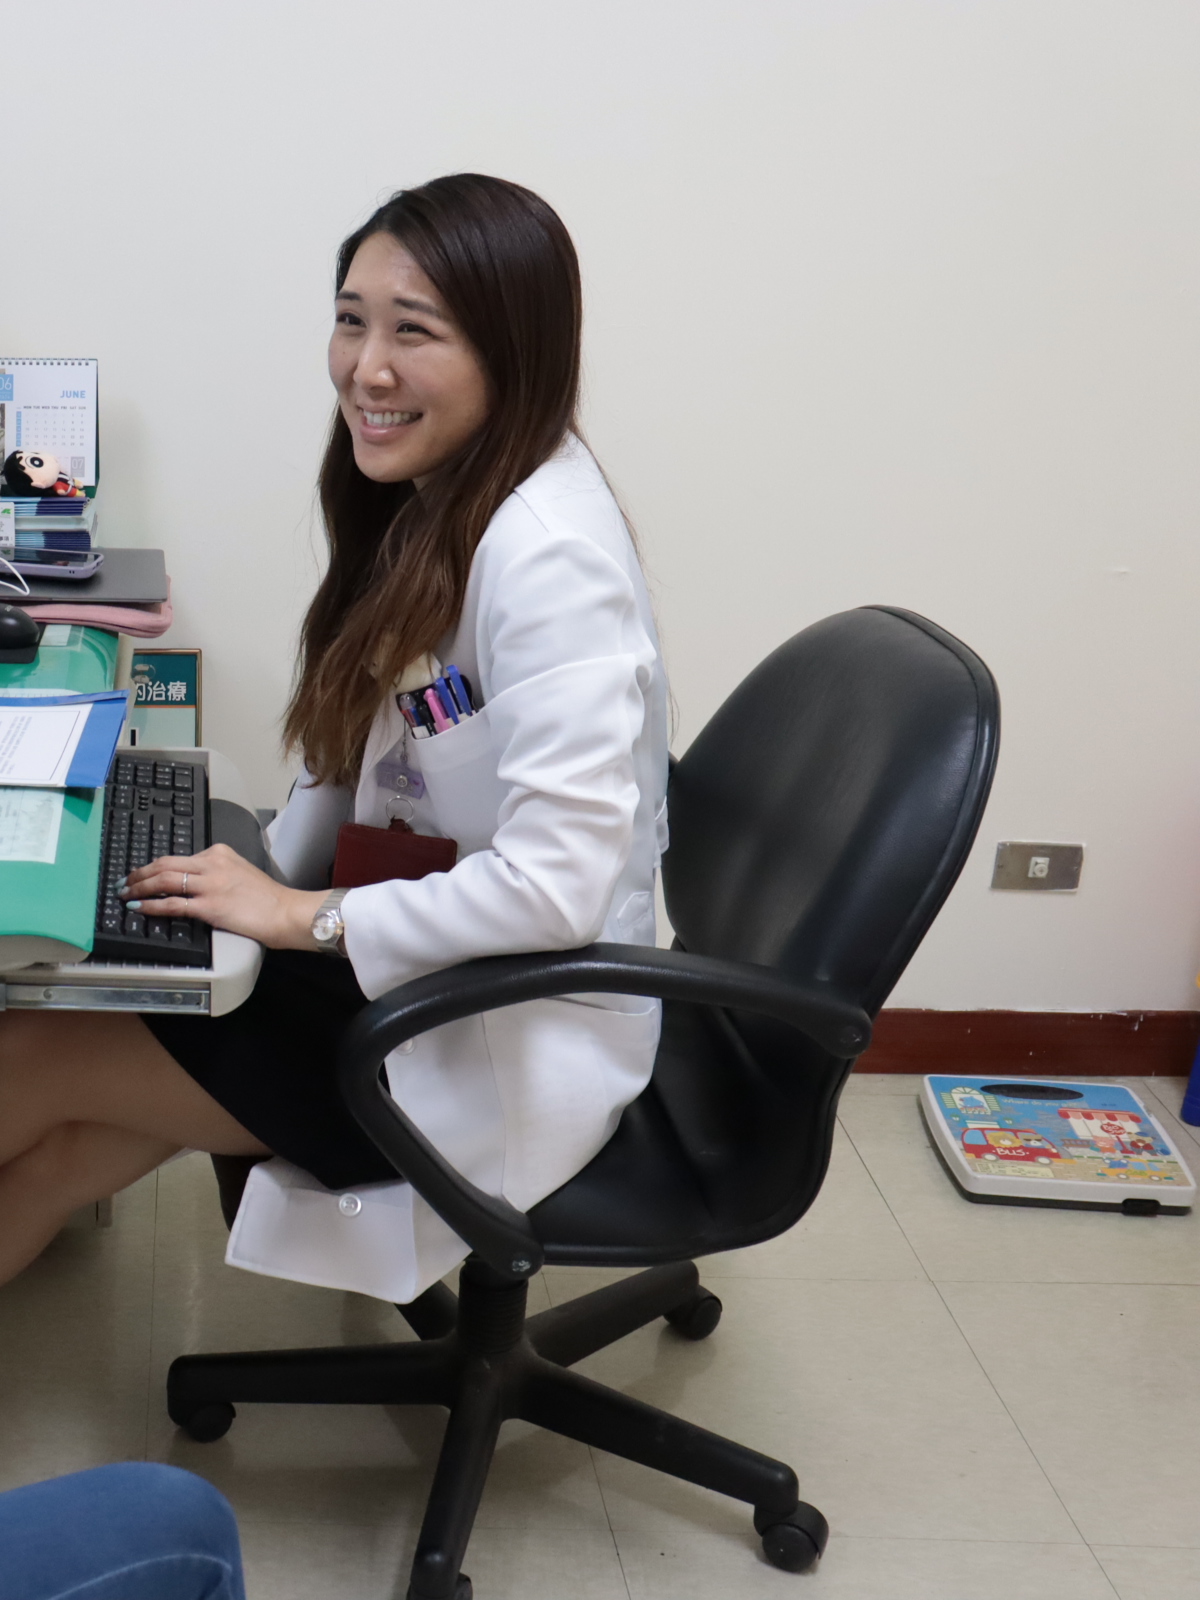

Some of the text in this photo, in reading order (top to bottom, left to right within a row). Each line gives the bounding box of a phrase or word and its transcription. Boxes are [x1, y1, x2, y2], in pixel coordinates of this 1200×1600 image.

[60, 390, 86, 398] JUNE
[72, 458, 84, 470] 07
[996, 1148, 1026, 1156] BUS
